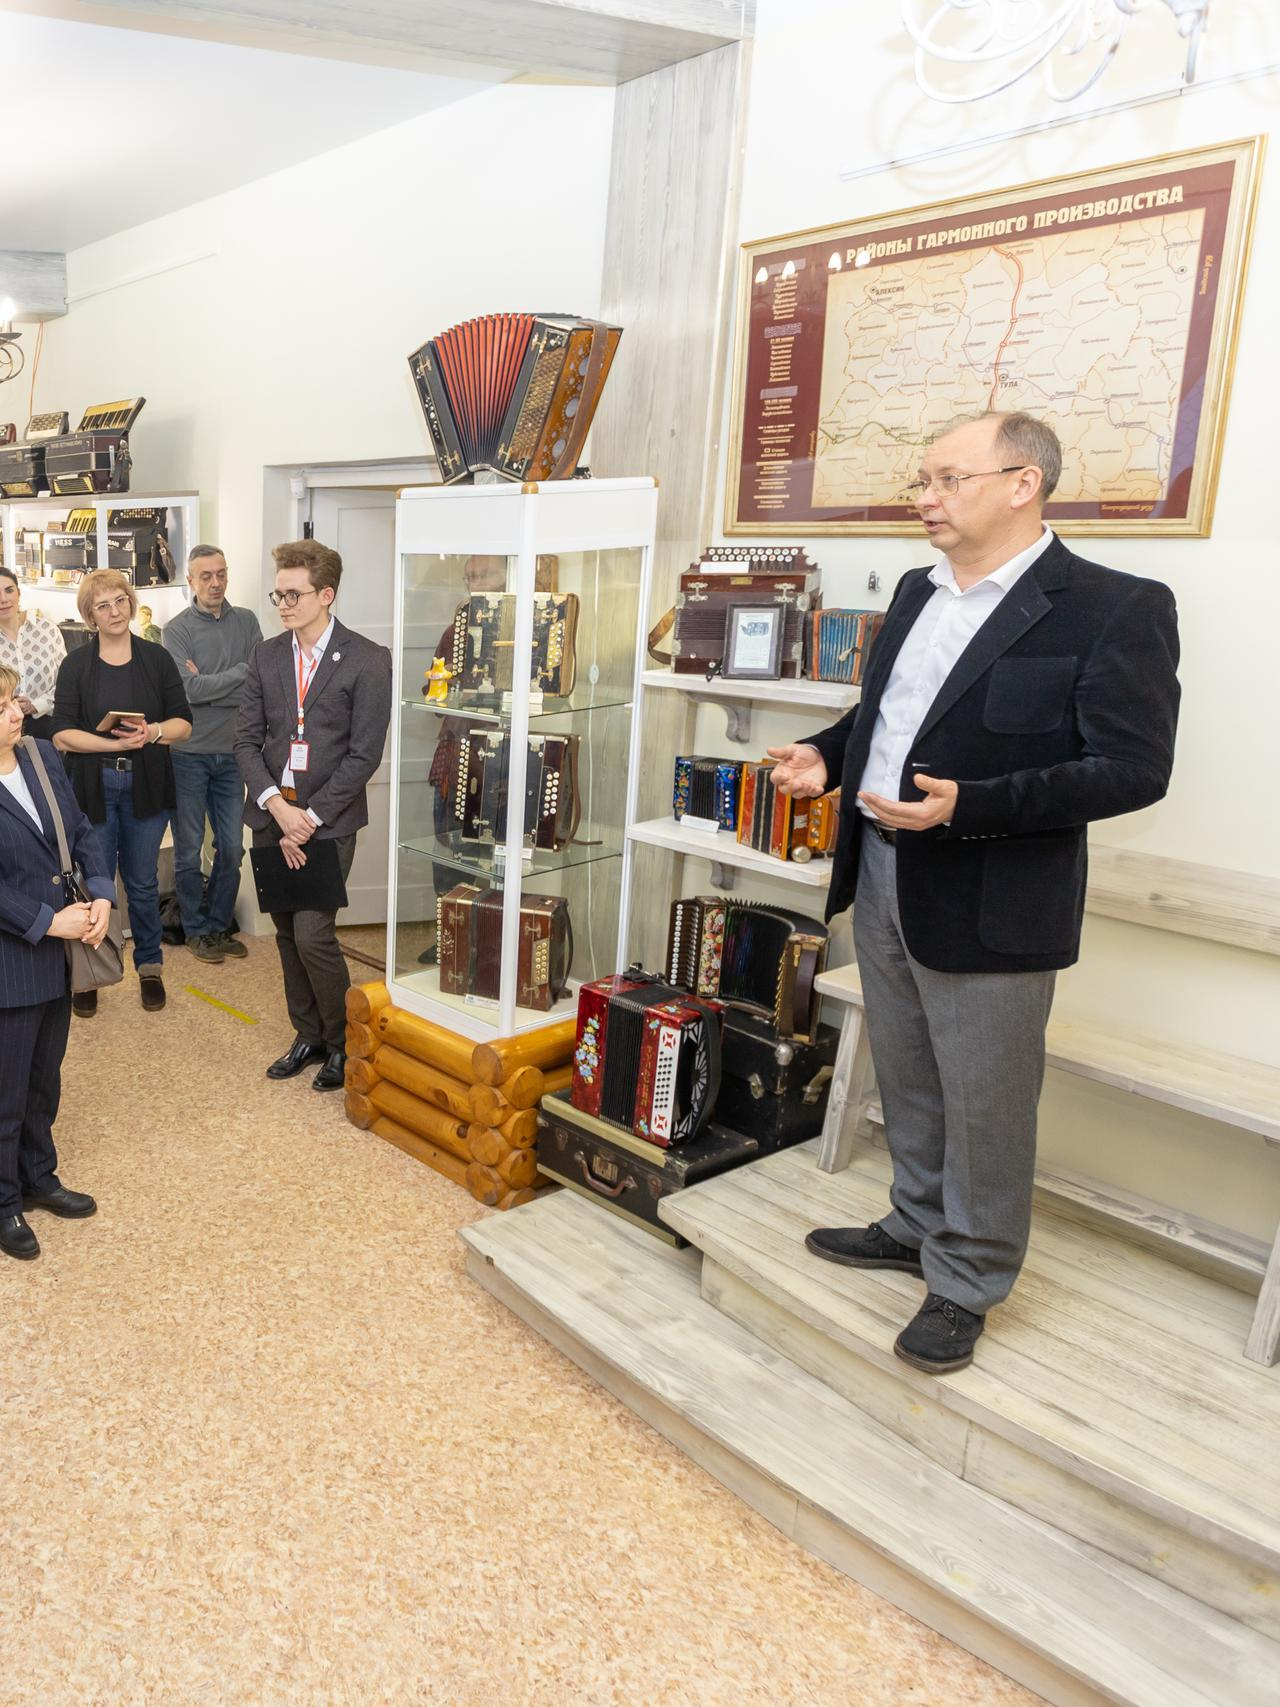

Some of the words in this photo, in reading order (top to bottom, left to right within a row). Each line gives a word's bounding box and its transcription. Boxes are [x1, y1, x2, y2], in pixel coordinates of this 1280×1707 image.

[917, 216, 1028, 250] ГАРМОННОГО
[1033, 185, 1184, 229] ПРОИЗВОДСТВА
[875, 286, 905, 295] АЛЕКСИН
